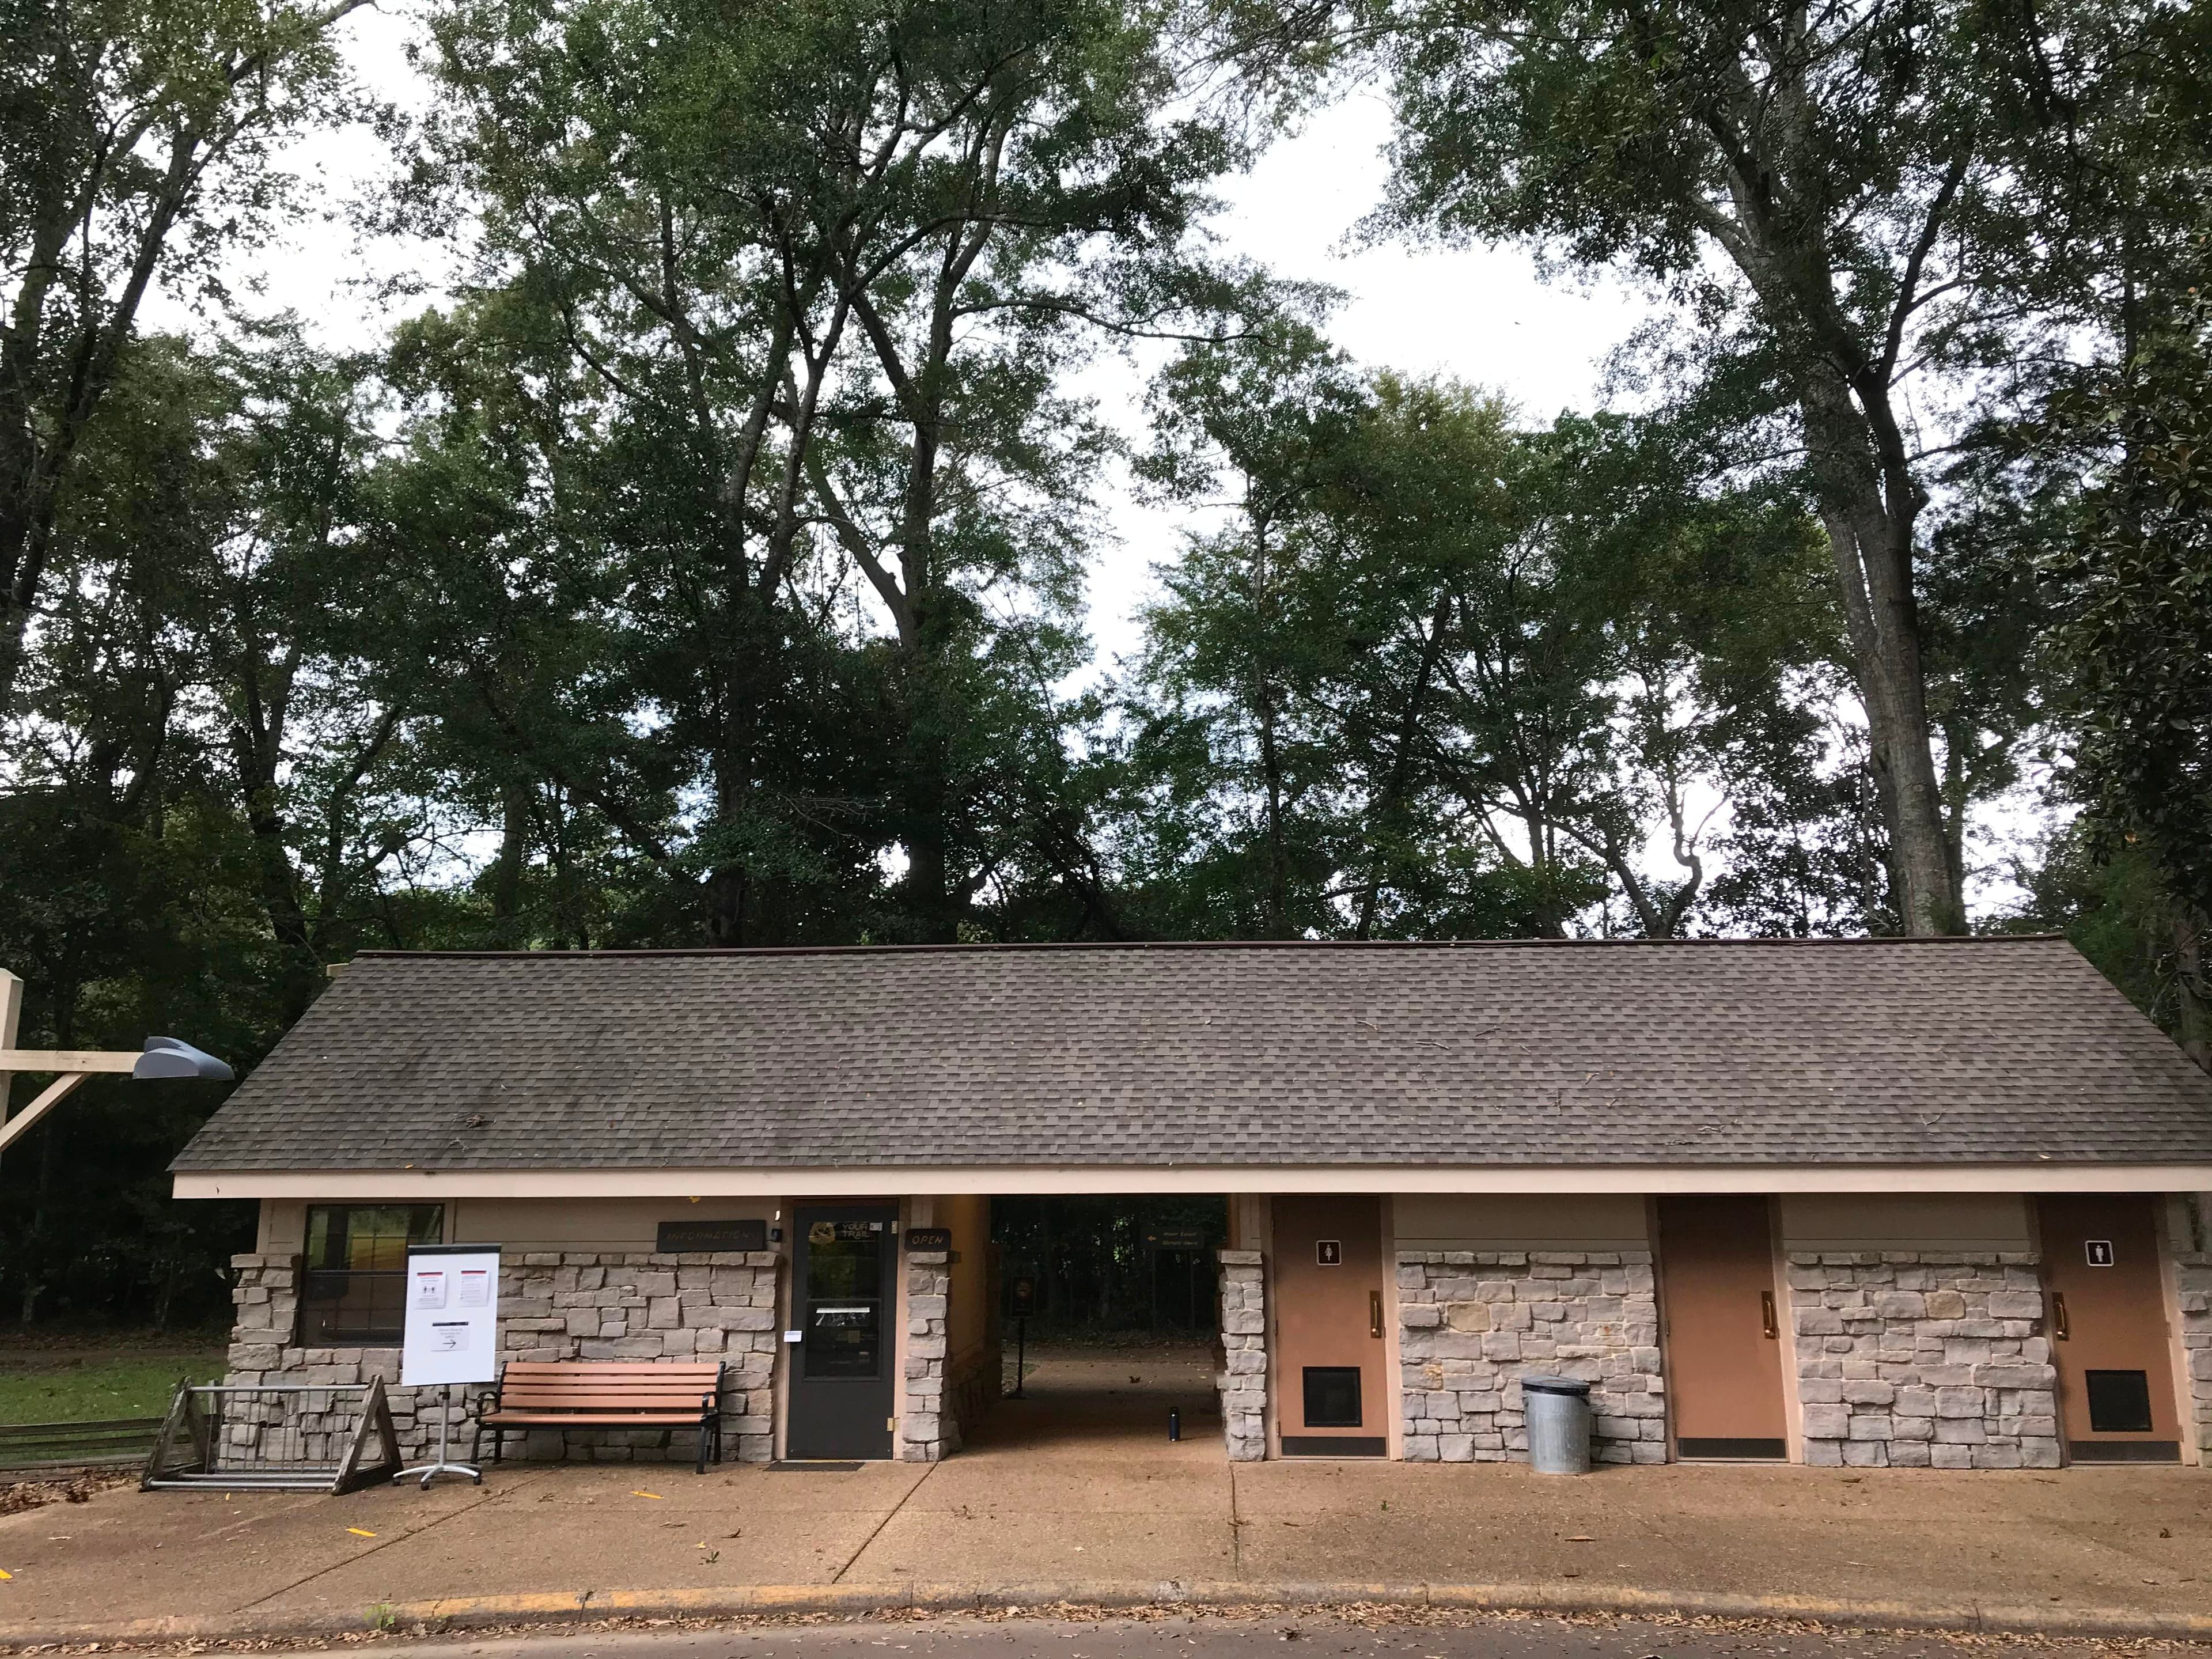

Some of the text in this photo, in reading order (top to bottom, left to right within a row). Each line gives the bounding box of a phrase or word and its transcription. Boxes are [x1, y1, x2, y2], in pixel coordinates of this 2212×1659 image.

[666, 1230, 752, 1240] INFORMATION
[843, 1230, 870, 1239] TRAIL
[912, 1234, 944, 1244] OPEN
